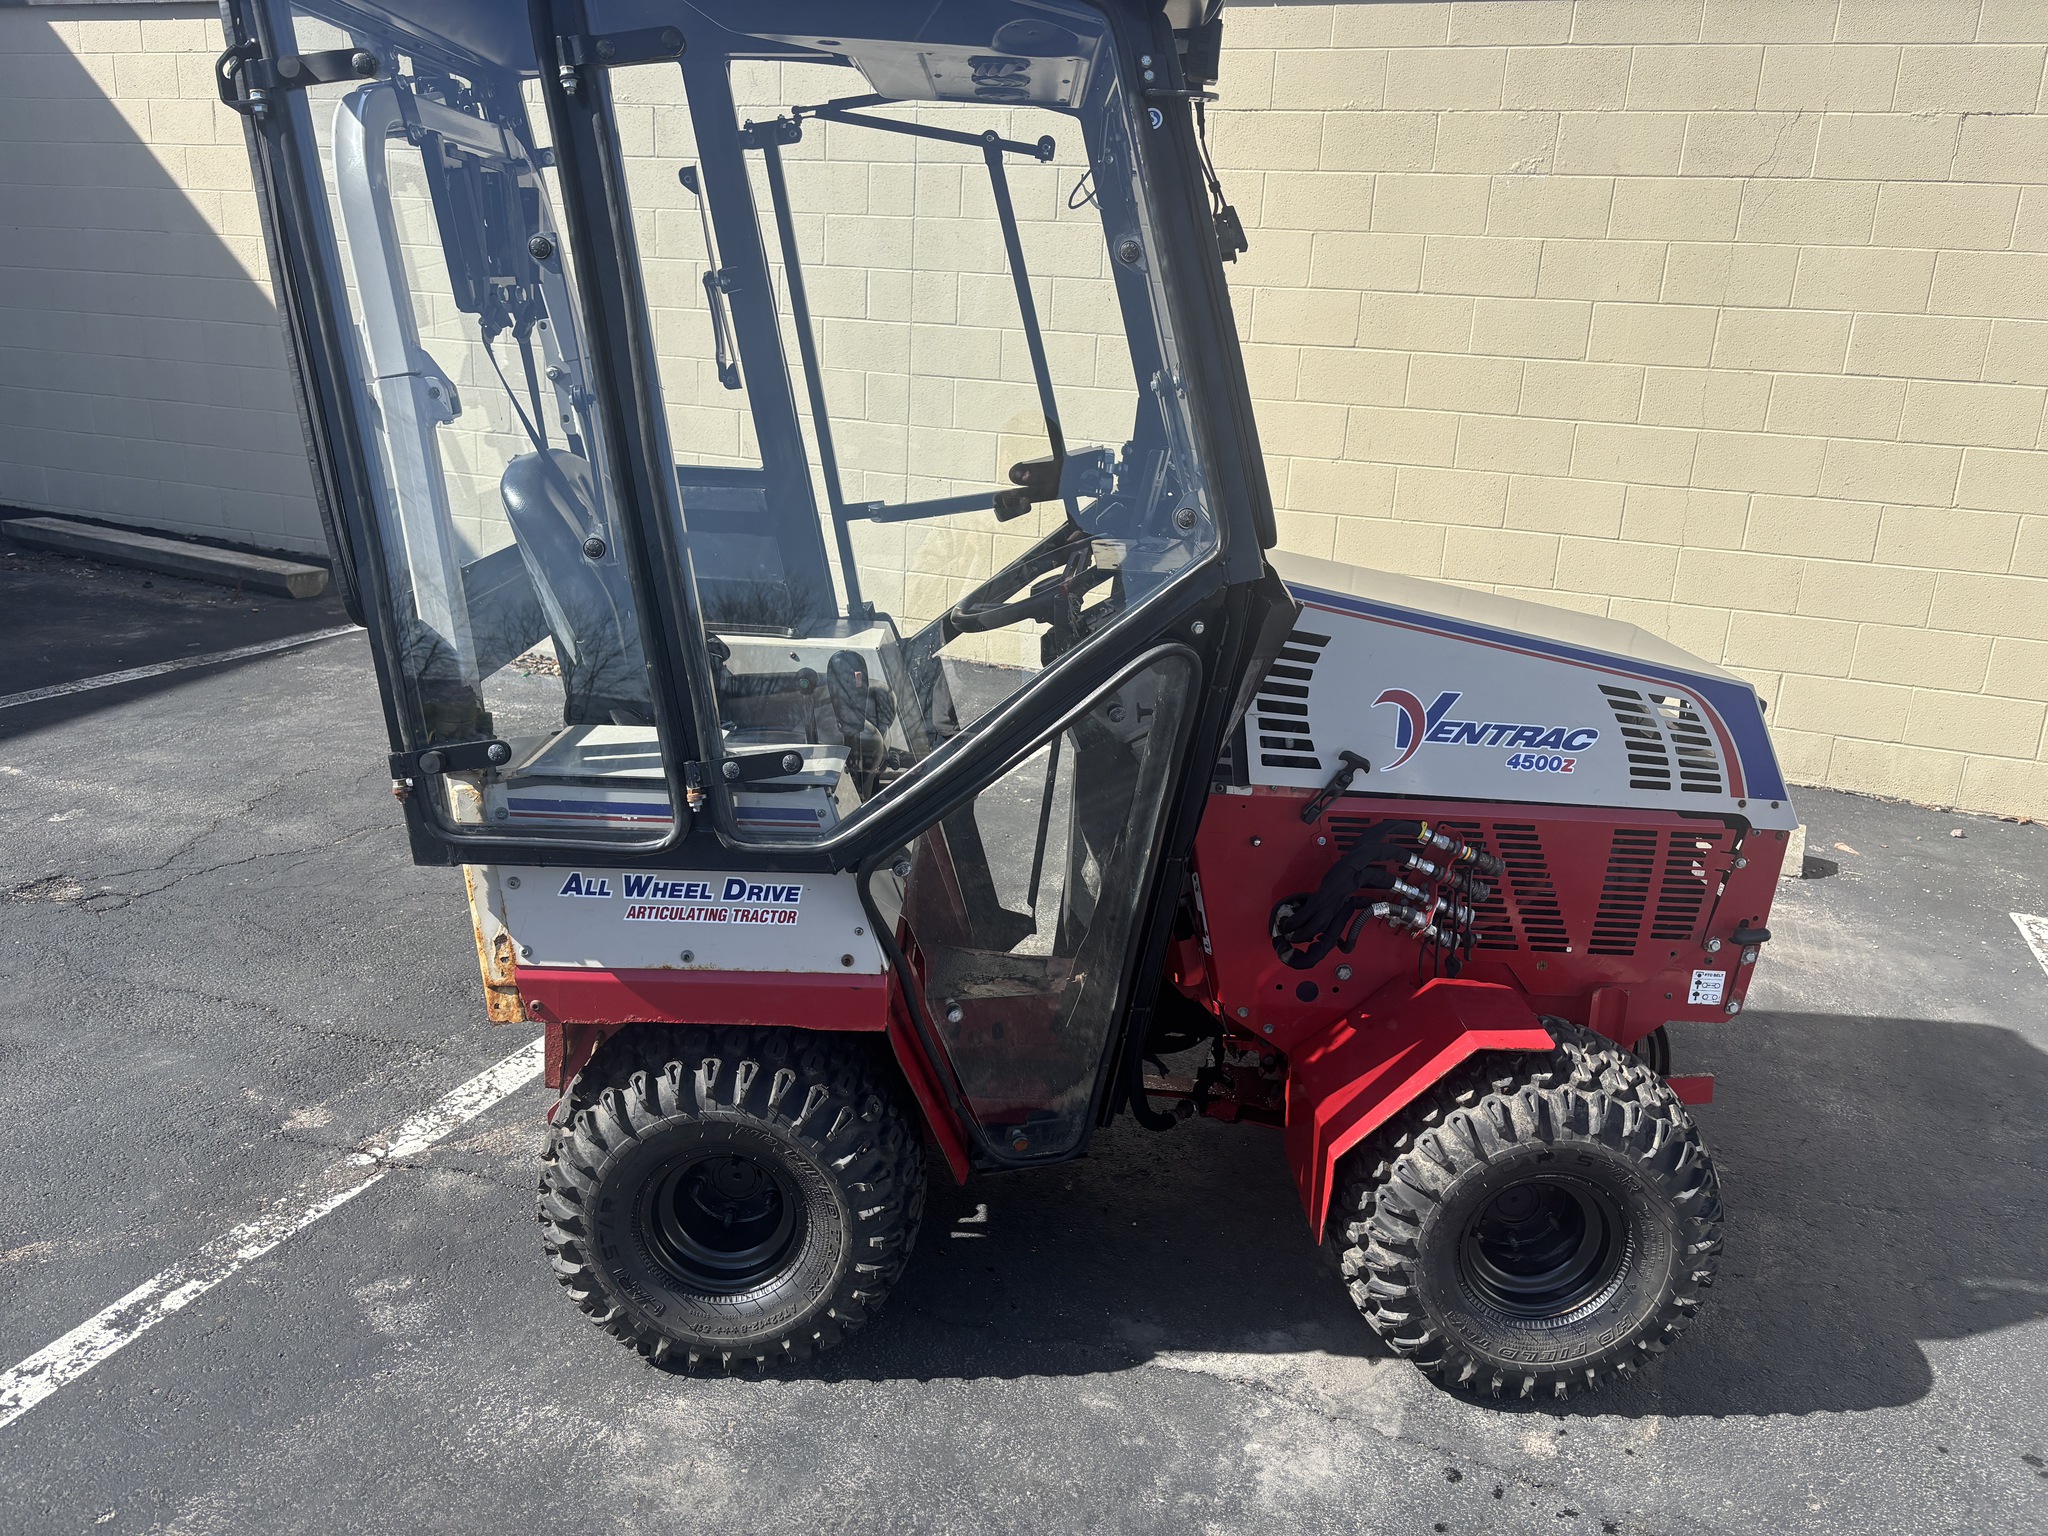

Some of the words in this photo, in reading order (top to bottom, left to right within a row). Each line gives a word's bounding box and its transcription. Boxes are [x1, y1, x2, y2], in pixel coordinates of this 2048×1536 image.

[1396, 690, 1599, 752] VENTRAC
[559, 872, 612, 897] ALL
[623, 874, 713, 900] WHEEL
[722, 878, 802, 903] DRIVE
[625, 905, 729, 922] ARTICULATING
[732, 908, 798, 924] TRACTOR
[808, 1229, 842, 1300] TRAX
[1598, 1314, 1635, 1346] HD
[1499, 1341, 1588, 1363] FIELD
